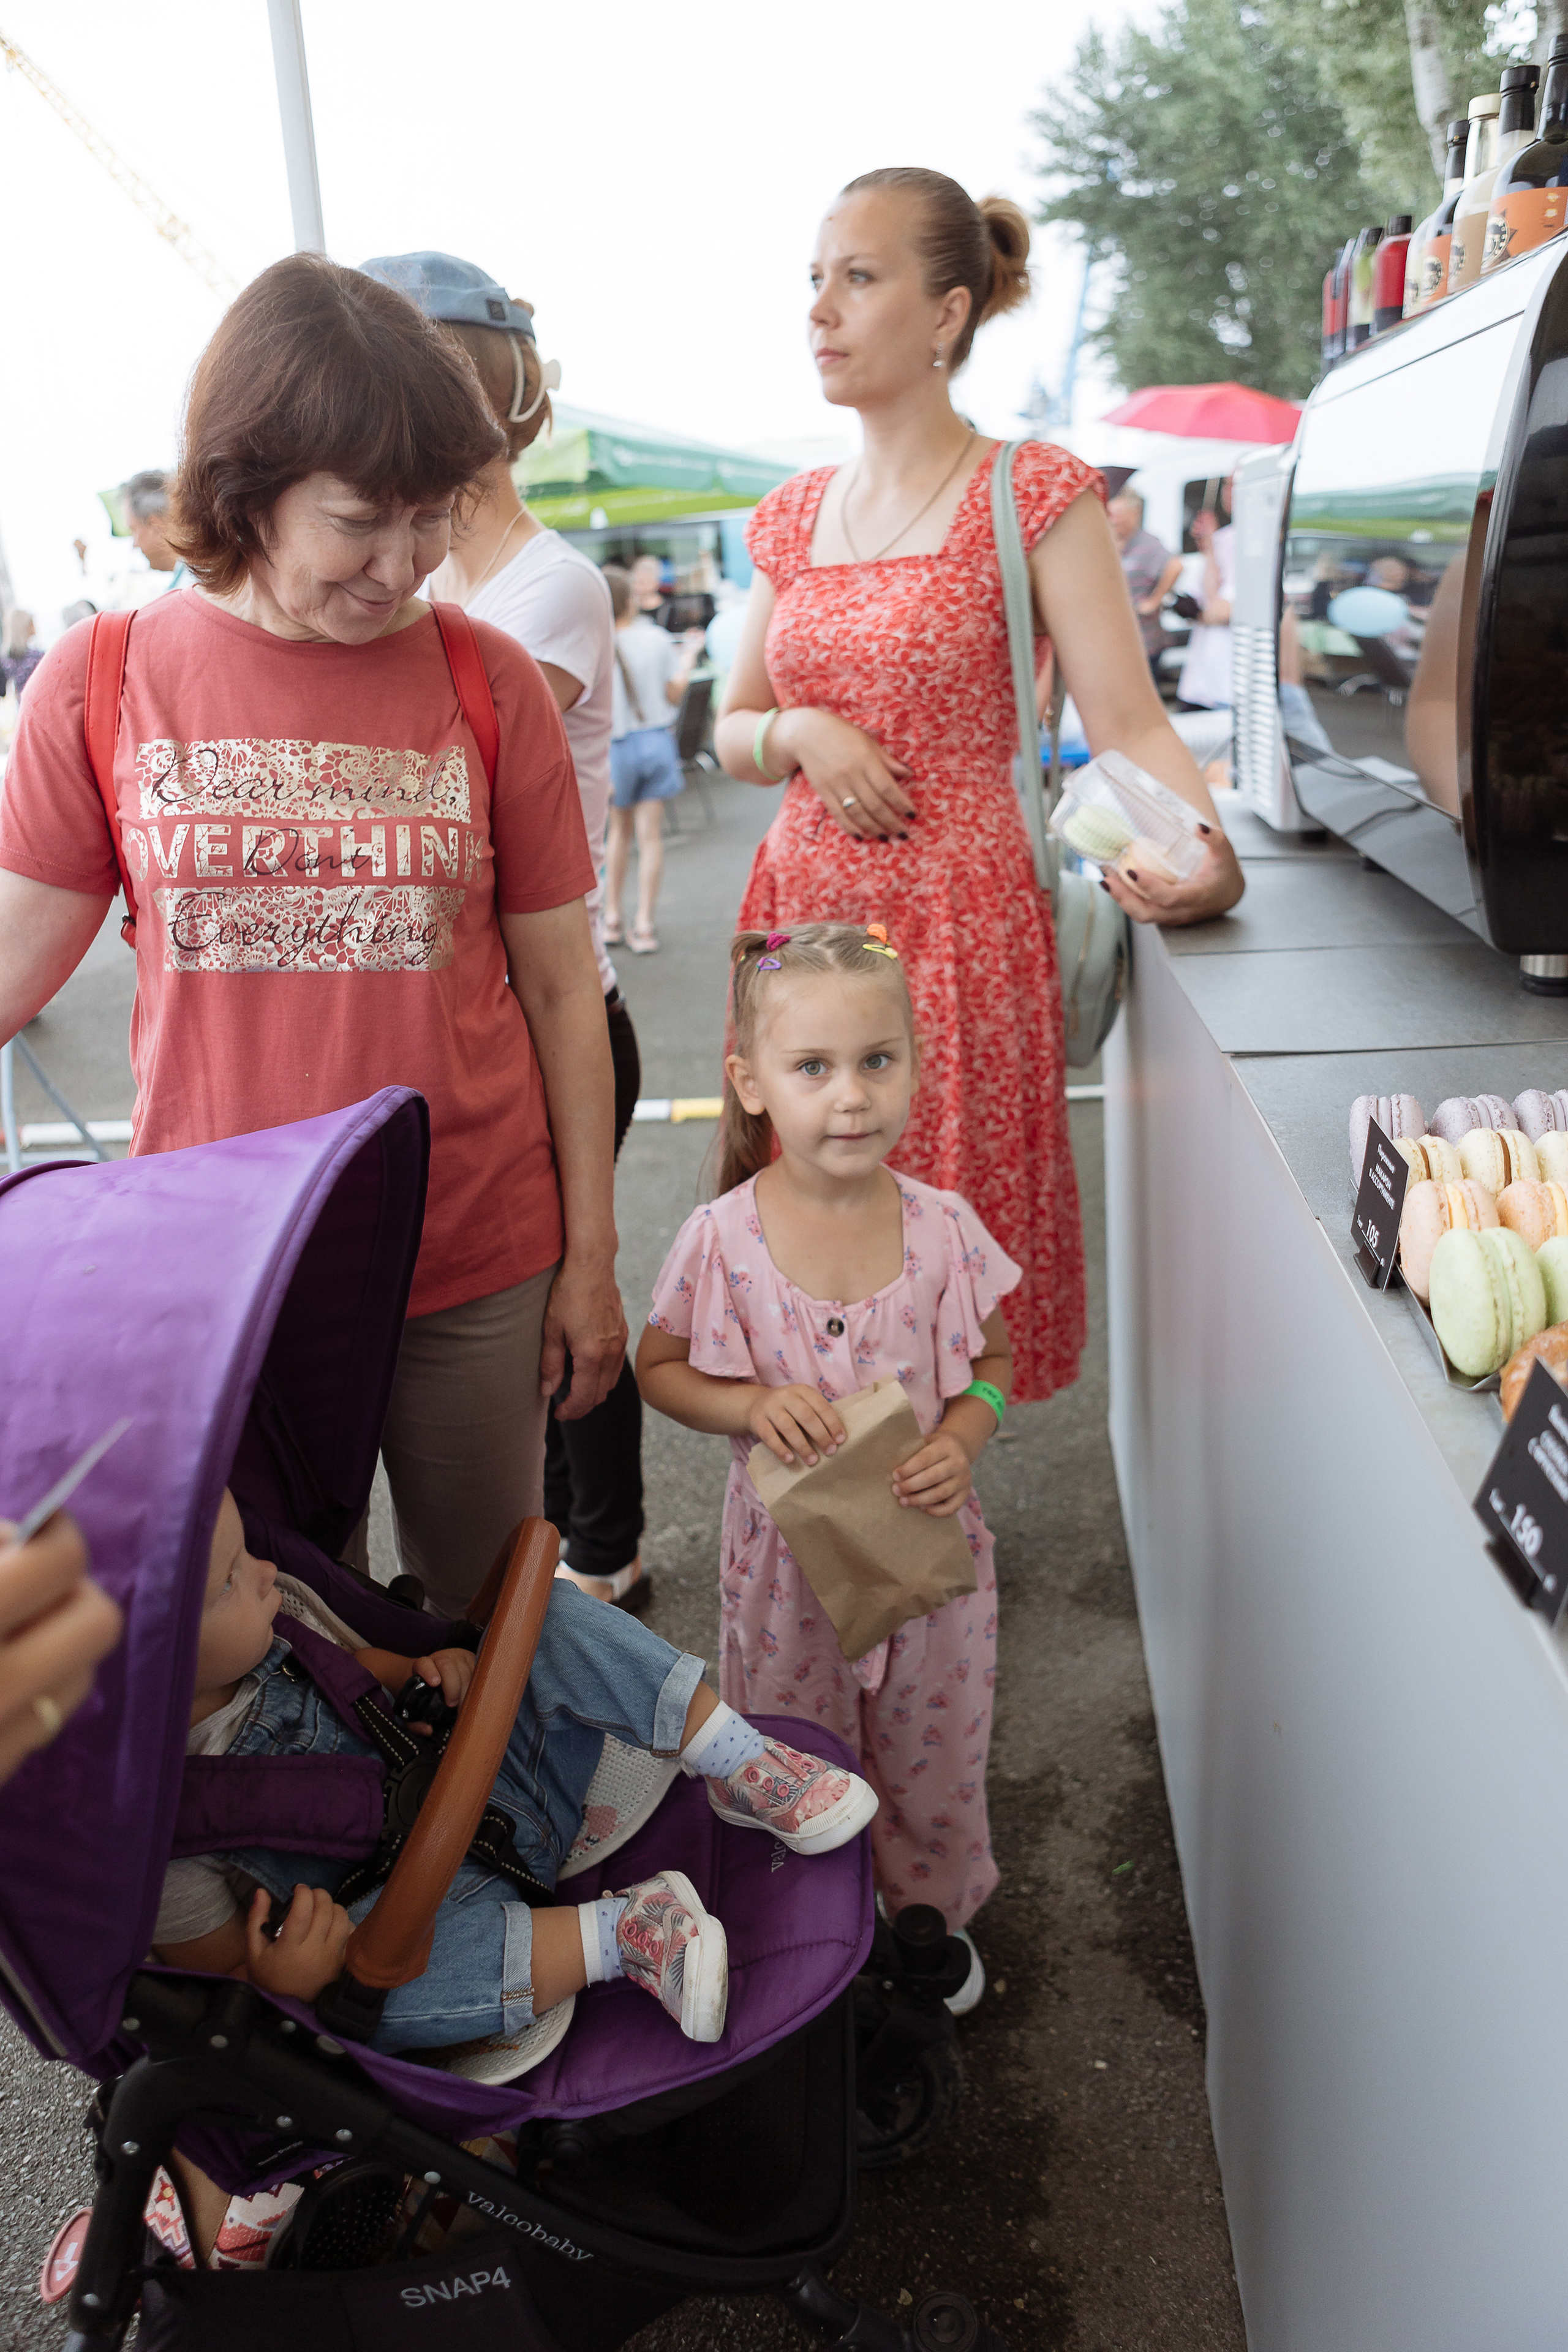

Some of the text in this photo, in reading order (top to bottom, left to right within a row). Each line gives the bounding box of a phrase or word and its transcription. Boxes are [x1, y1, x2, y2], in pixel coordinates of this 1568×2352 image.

[151, 749, 456, 805] Dear mind,
[126, 823, 486, 882] OVERTHINK
[168, 892, 438, 967] Everything
[1366, 1219, 1380, 1248] 105
[467, 2190, 594, 2261] valcobaby
[400, 2266, 511, 2308] SNAP4
